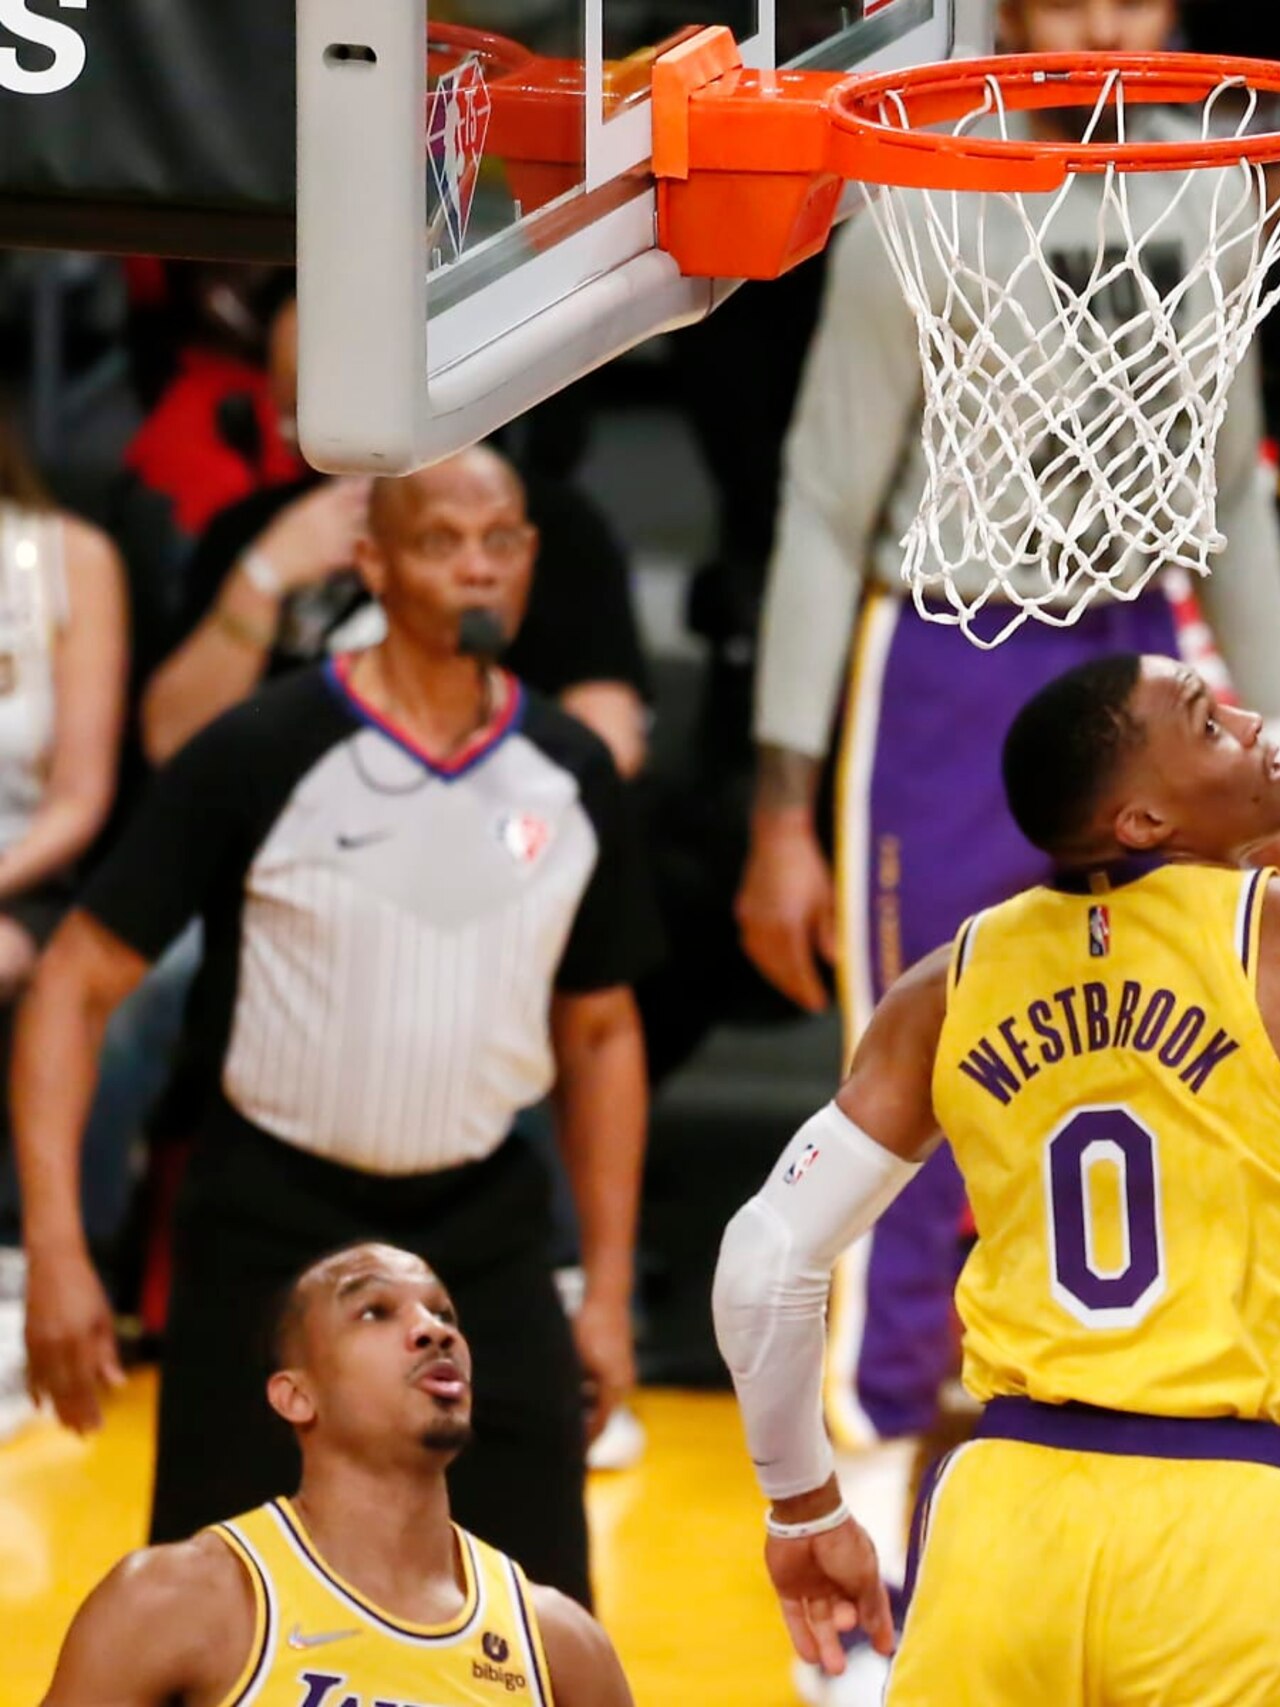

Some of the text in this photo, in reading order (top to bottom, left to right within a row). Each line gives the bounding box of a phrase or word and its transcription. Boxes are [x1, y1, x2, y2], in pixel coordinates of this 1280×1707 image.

[958, 980, 1241, 1107] WESTBROOK
[1046, 1102, 1168, 1330] 0
[471, 1660, 526, 1691] bibigo
